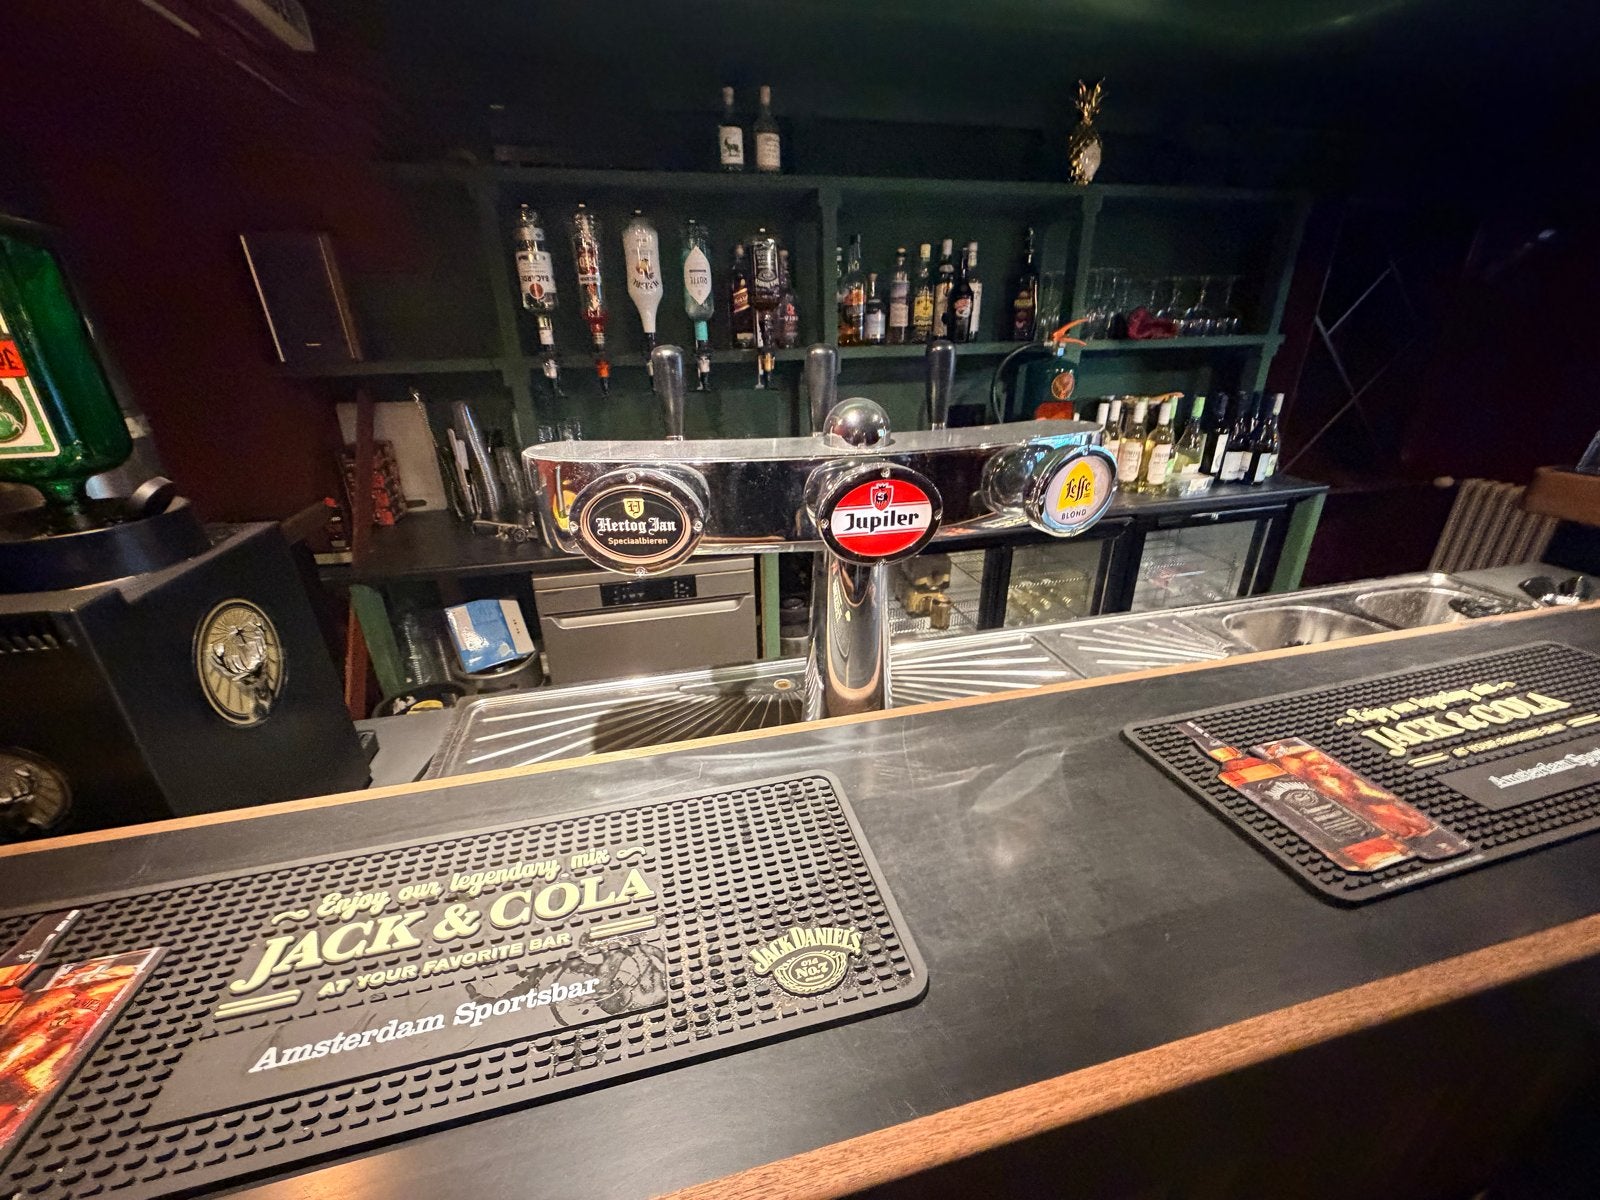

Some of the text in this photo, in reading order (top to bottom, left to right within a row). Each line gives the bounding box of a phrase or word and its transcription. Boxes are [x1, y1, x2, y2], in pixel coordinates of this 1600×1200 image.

[1065, 475, 1091, 502] Leffe
[596, 516, 677, 536] Hertog Jan
[843, 510, 919, 533] Jupiler
[1061, 509, 1087, 520] BLOND
[608, 537, 668, 546] Speciaalbieren
[1361, 715, 1466, 757] JACK
[1469, 692, 1572, 724] COLA
[316, 848, 610, 921] Enjoy our legendary mix
[230, 868, 655, 994] JACK & COLA
[749, 926, 862, 975] JACK DANIEL'S
[317, 932, 572, 999] AT YOUR FAVORITE BAR
[248, 975, 600, 1073] Amsterdam Sportsbar
